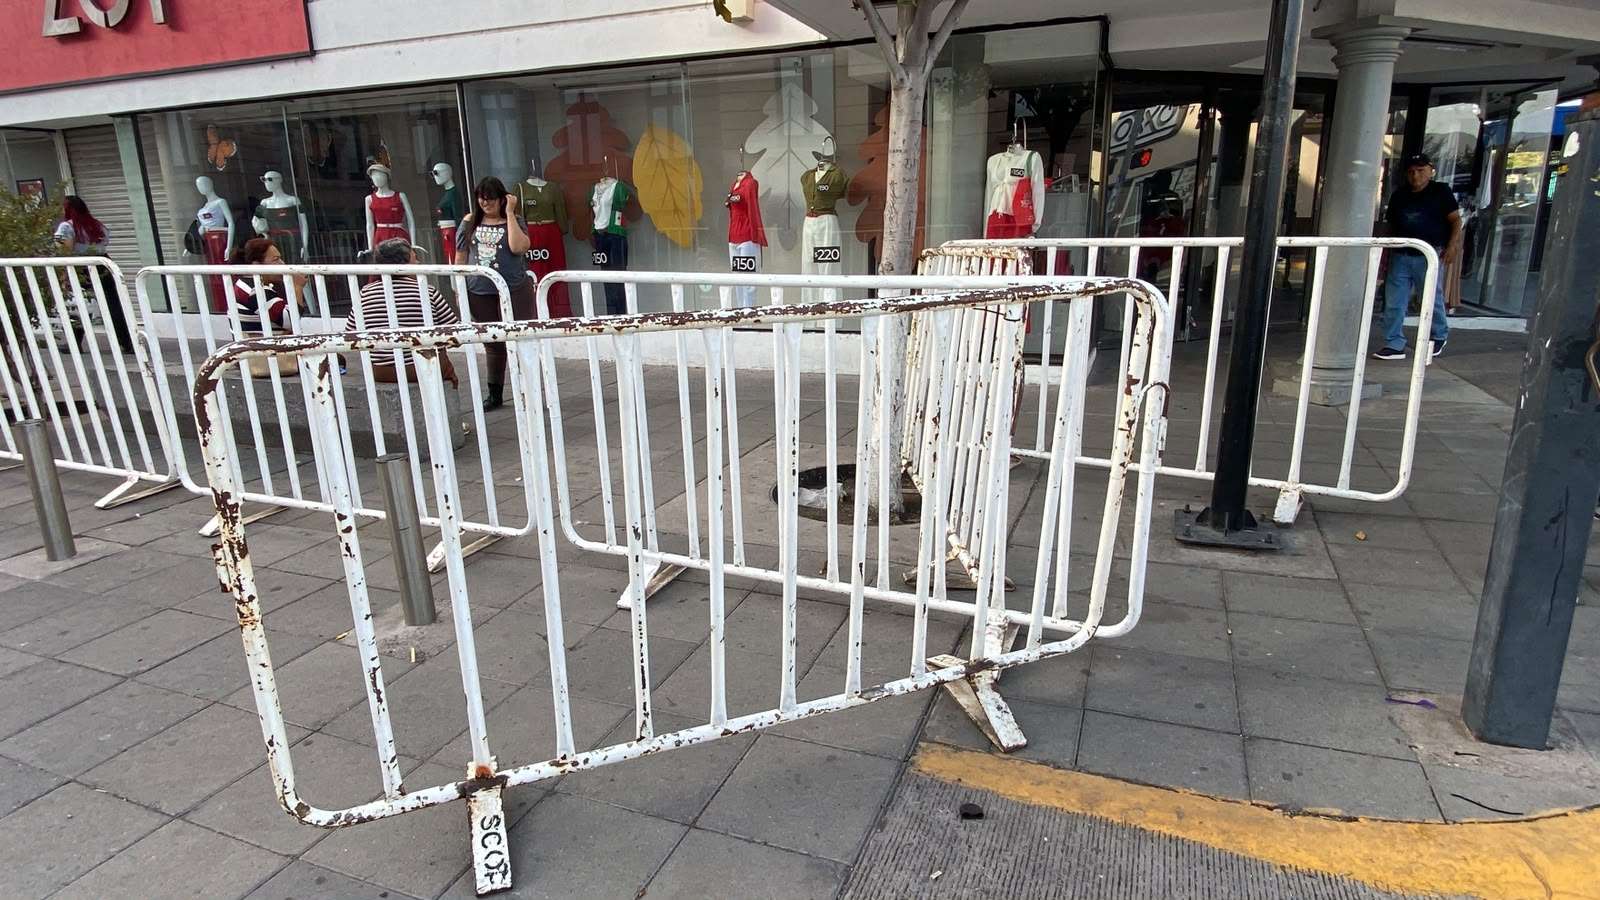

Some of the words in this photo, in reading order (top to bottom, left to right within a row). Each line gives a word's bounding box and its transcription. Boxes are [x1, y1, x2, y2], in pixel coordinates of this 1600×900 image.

[525, 249, 550, 260] $190
[814, 249, 840, 260] $220
[733, 258, 755, 270] $150
